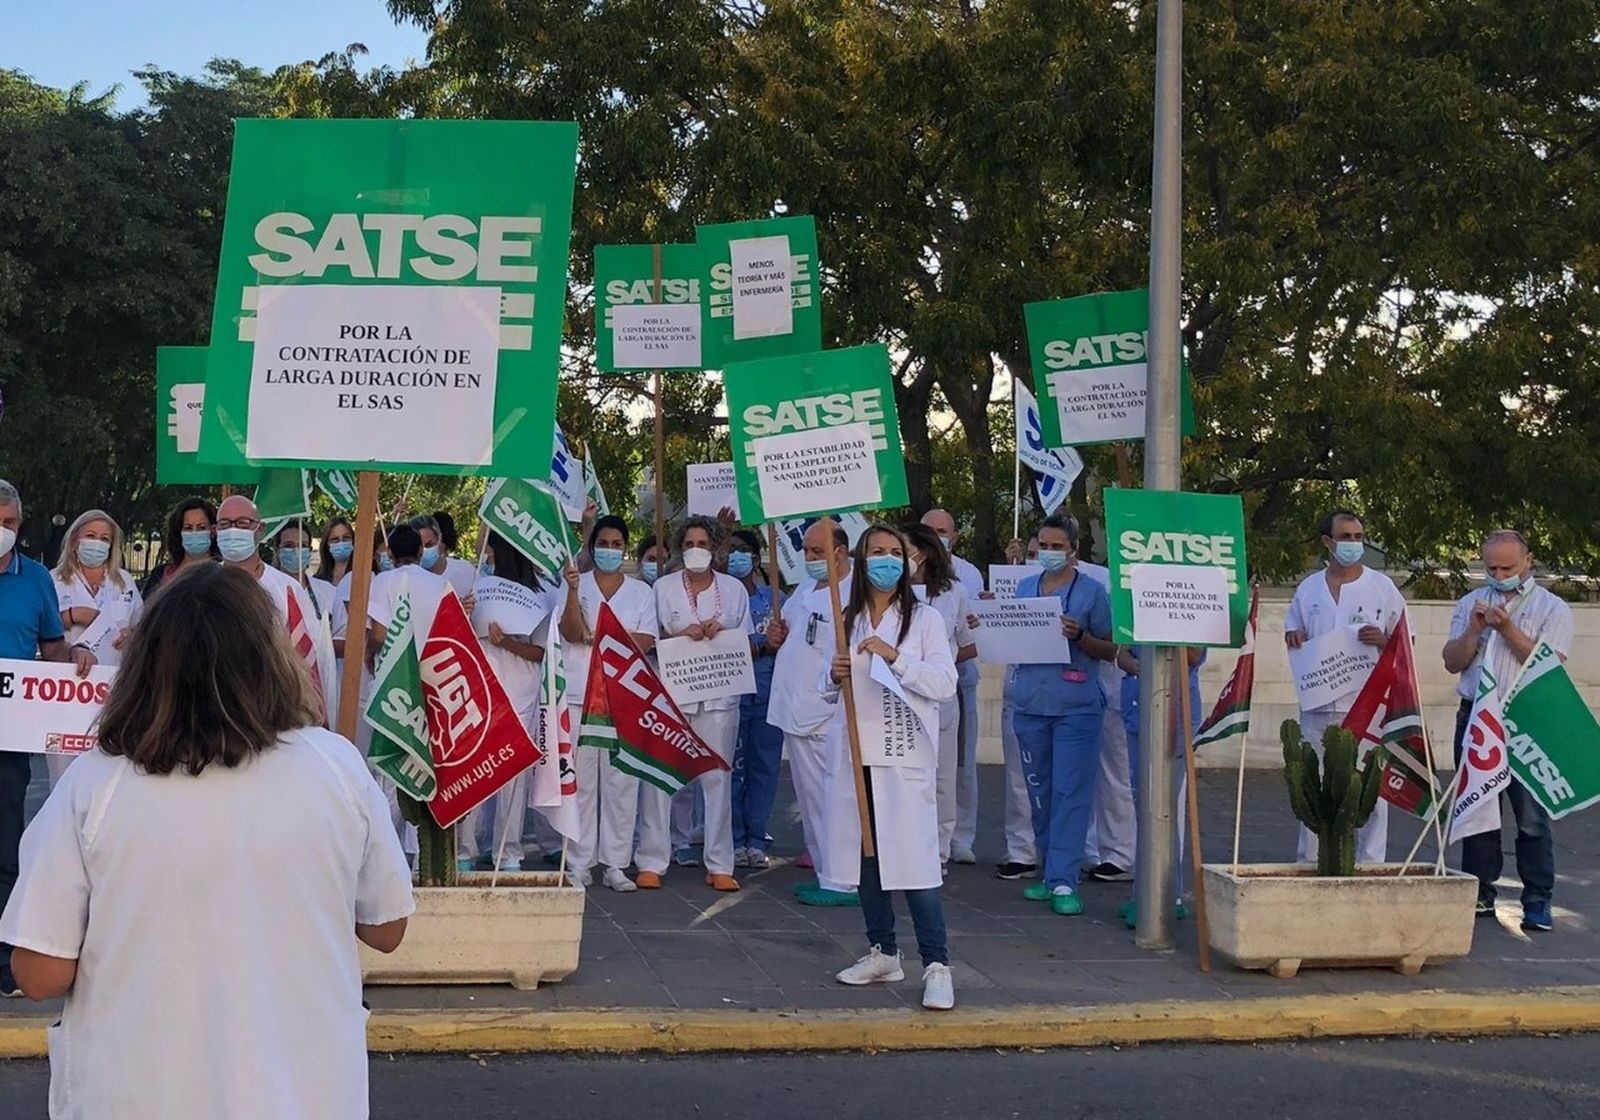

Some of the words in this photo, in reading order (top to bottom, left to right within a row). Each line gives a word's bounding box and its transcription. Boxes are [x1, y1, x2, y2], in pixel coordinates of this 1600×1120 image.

[248, 212, 541, 282] SATSE
[748, 259, 774, 270] MENOS
[737, 272, 762, 284] TEORÍA
[762, 274, 769, 282] Y
[769, 270, 786, 281] MÁS
[740, 284, 784, 297] ENFERMERÍA
[338, 324, 380, 340] POR
[386, 325, 413, 340] LA
[278, 345, 439, 364] CONTRATACIÓN
[443, 349, 472, 364] DE
[265, 369, 335, 386] LARGA
[340, 368, 449, 388] DURACIÓN
[454, 374, 482, 388] EN
[1092, 382, 1110, 392] POR
[1112, 382, 1125, 390] LA
[336, 394, 364, 409] EL
[366, 394, 404, 410] SAS
[1064, 402, 1096, 414] LARGA
[743, 388, 884, 436] SATSE
[1110, 411, 1128, 420] SAS
[763, 452, 785, 464] POR
[786, 450, 800, 460] LA
[800, 440, 866, 458] ESTABILIDAD
[764, 462, 780, 474] EN
[780, 462, 794, 471] EL
[794, 455, 836, 470] EMPLEO
[838, 452, 852, 462] EN
[853, 450, 868, 460] LA
[773, 470, 818, 482] SANIDAD
[792, 475, 847, 491] ANDALUZA
[494, 496, 568, 570] SATSE
[1120, 530, 1236, 566] SATSE
[1166, 581, 1184, 590] POR
[1184, 582, 1195, 590] LA
[1138, 600, 1168, 609] LARGA
[1212, 604, 1224, 612] EN
[1168, 612, 1180, 620] EL
[1180, 612, 1196, 620] SAS
[665, 661, 681, 670] POR
[692, 652, 746, 665] ESTABILIDAD
[722, 661, 735, 669] EN
[736, 660, 747, 668] LA
[22, 676, 109, 704] TODOS
[688, 679, 731, 692] ANDALUZA
[420, 648, 484, 742] UGT
[638, 710, 700, 759] Sevilla
[884, 720, 892, 734] LA
[896, 729, 904, 742] EL
[884, 736, 893, 758] POR
[896, 743, 904, 757] EN
[440, 743, 516, 802] www.ugt.es
[1022, 750, 1042, 810] UCI
